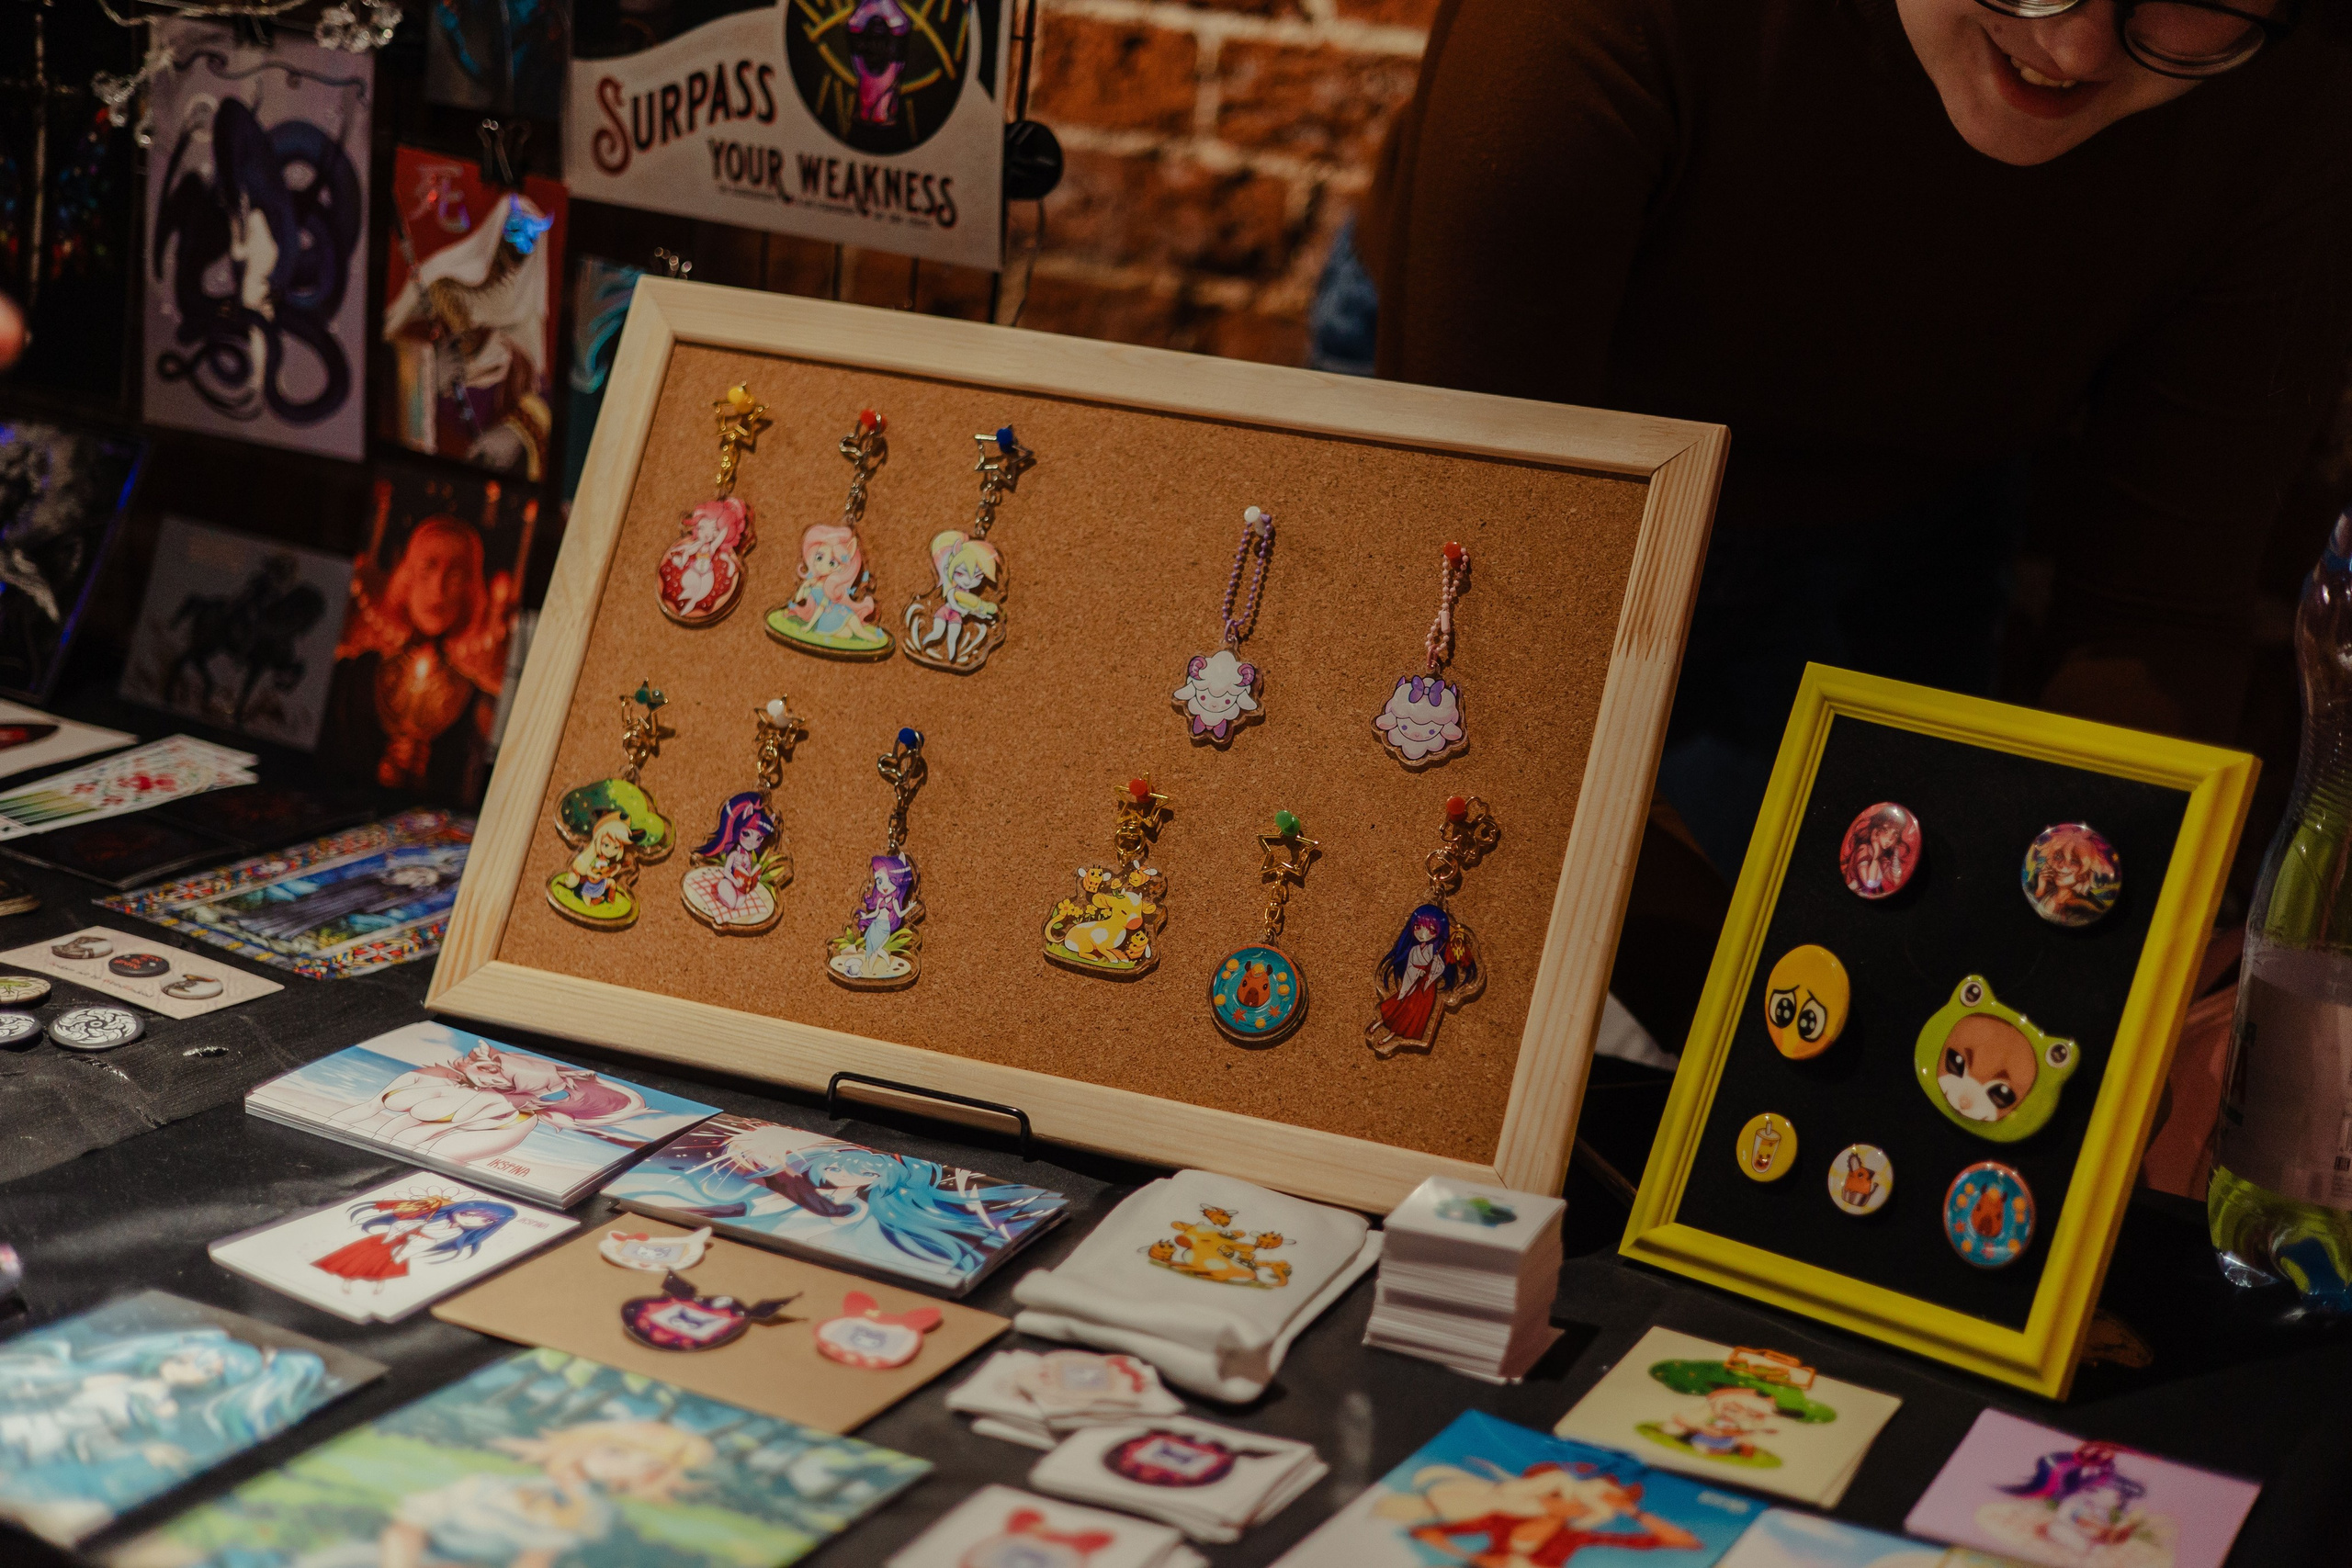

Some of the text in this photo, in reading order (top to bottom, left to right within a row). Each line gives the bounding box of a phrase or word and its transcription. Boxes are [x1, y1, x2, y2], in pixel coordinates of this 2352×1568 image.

[592, 60, 776, 175] SURPASS
[411, 164, 471, 233] 死
[707, 138, 794, 202] YOUR
[797, 152, 956, 229] WEAKNESS
